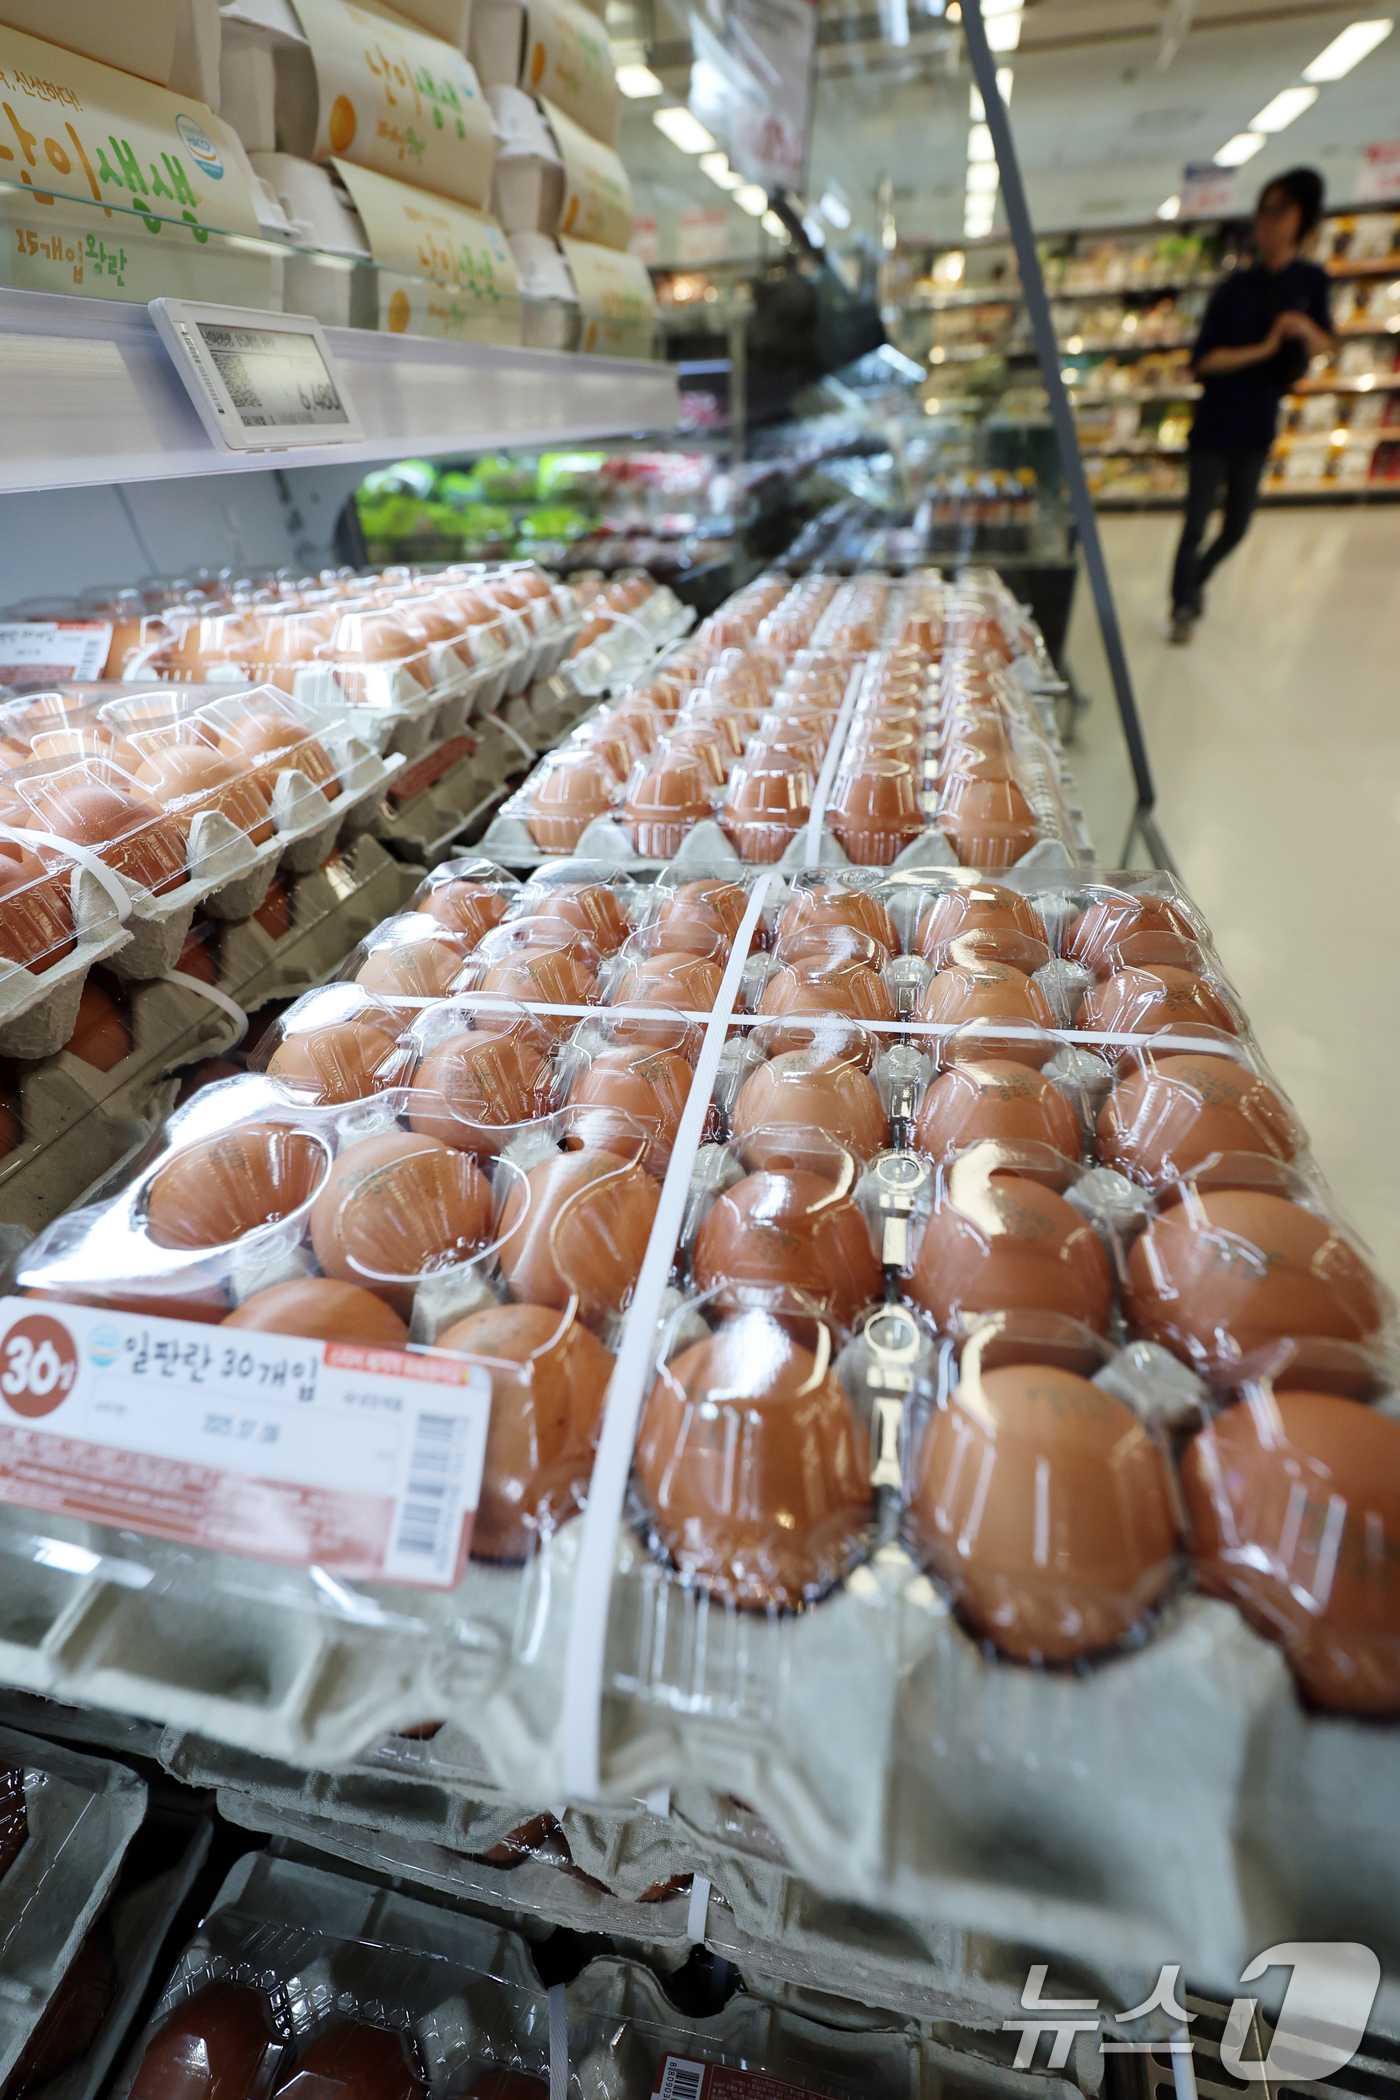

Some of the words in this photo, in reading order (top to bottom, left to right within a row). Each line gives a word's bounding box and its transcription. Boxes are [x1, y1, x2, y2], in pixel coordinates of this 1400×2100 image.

[13, 69, 83, 112] 신선하다!
[125, 1332, 213, 1383] 일판란
[221, 1349, 318, 1401] 30개입
